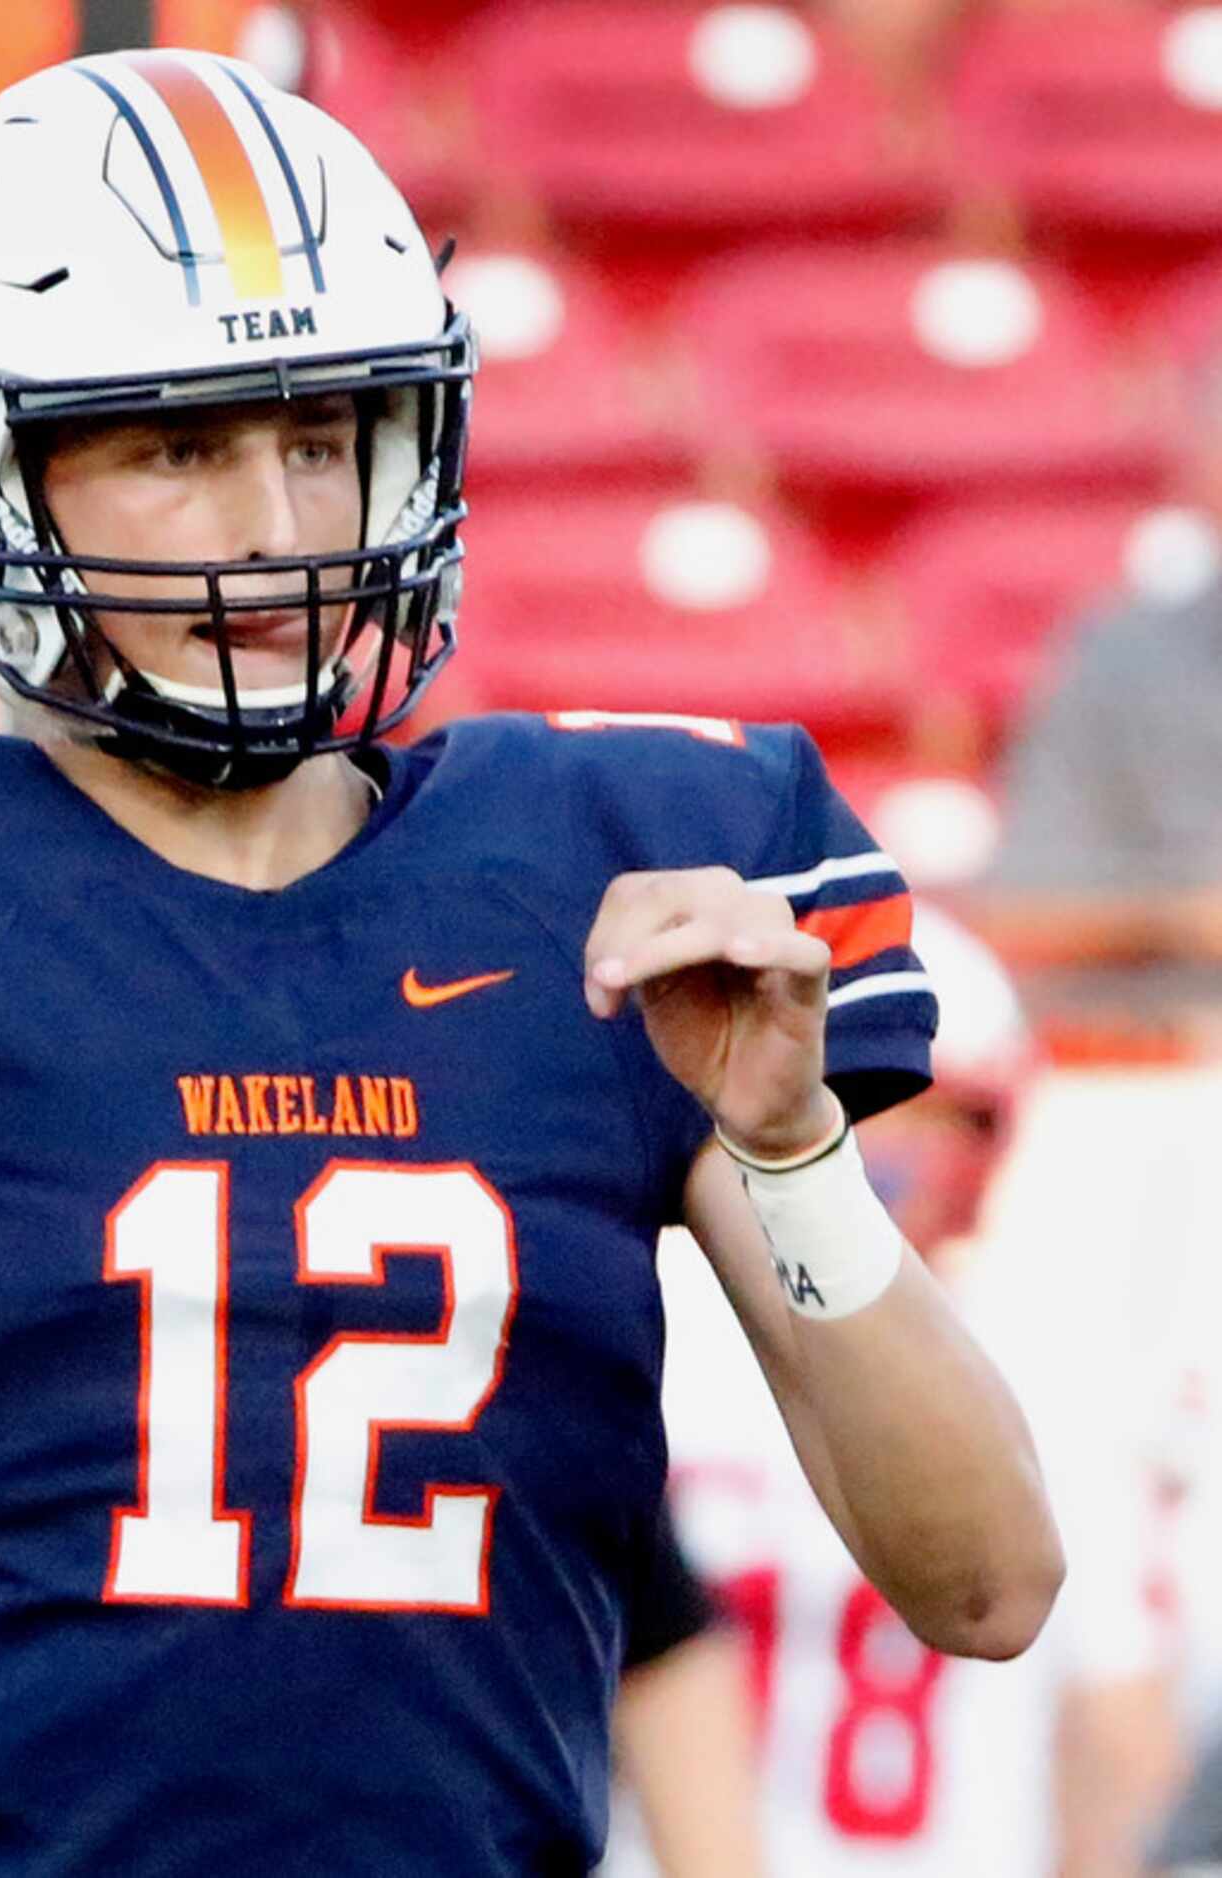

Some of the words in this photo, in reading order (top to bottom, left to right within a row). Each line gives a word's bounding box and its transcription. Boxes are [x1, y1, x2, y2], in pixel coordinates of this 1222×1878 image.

[218, 306, 318, 344] TEAM
[176, 1073, 420, 1138] WAKELAND
[101, 1158, 519, 1616] 12
